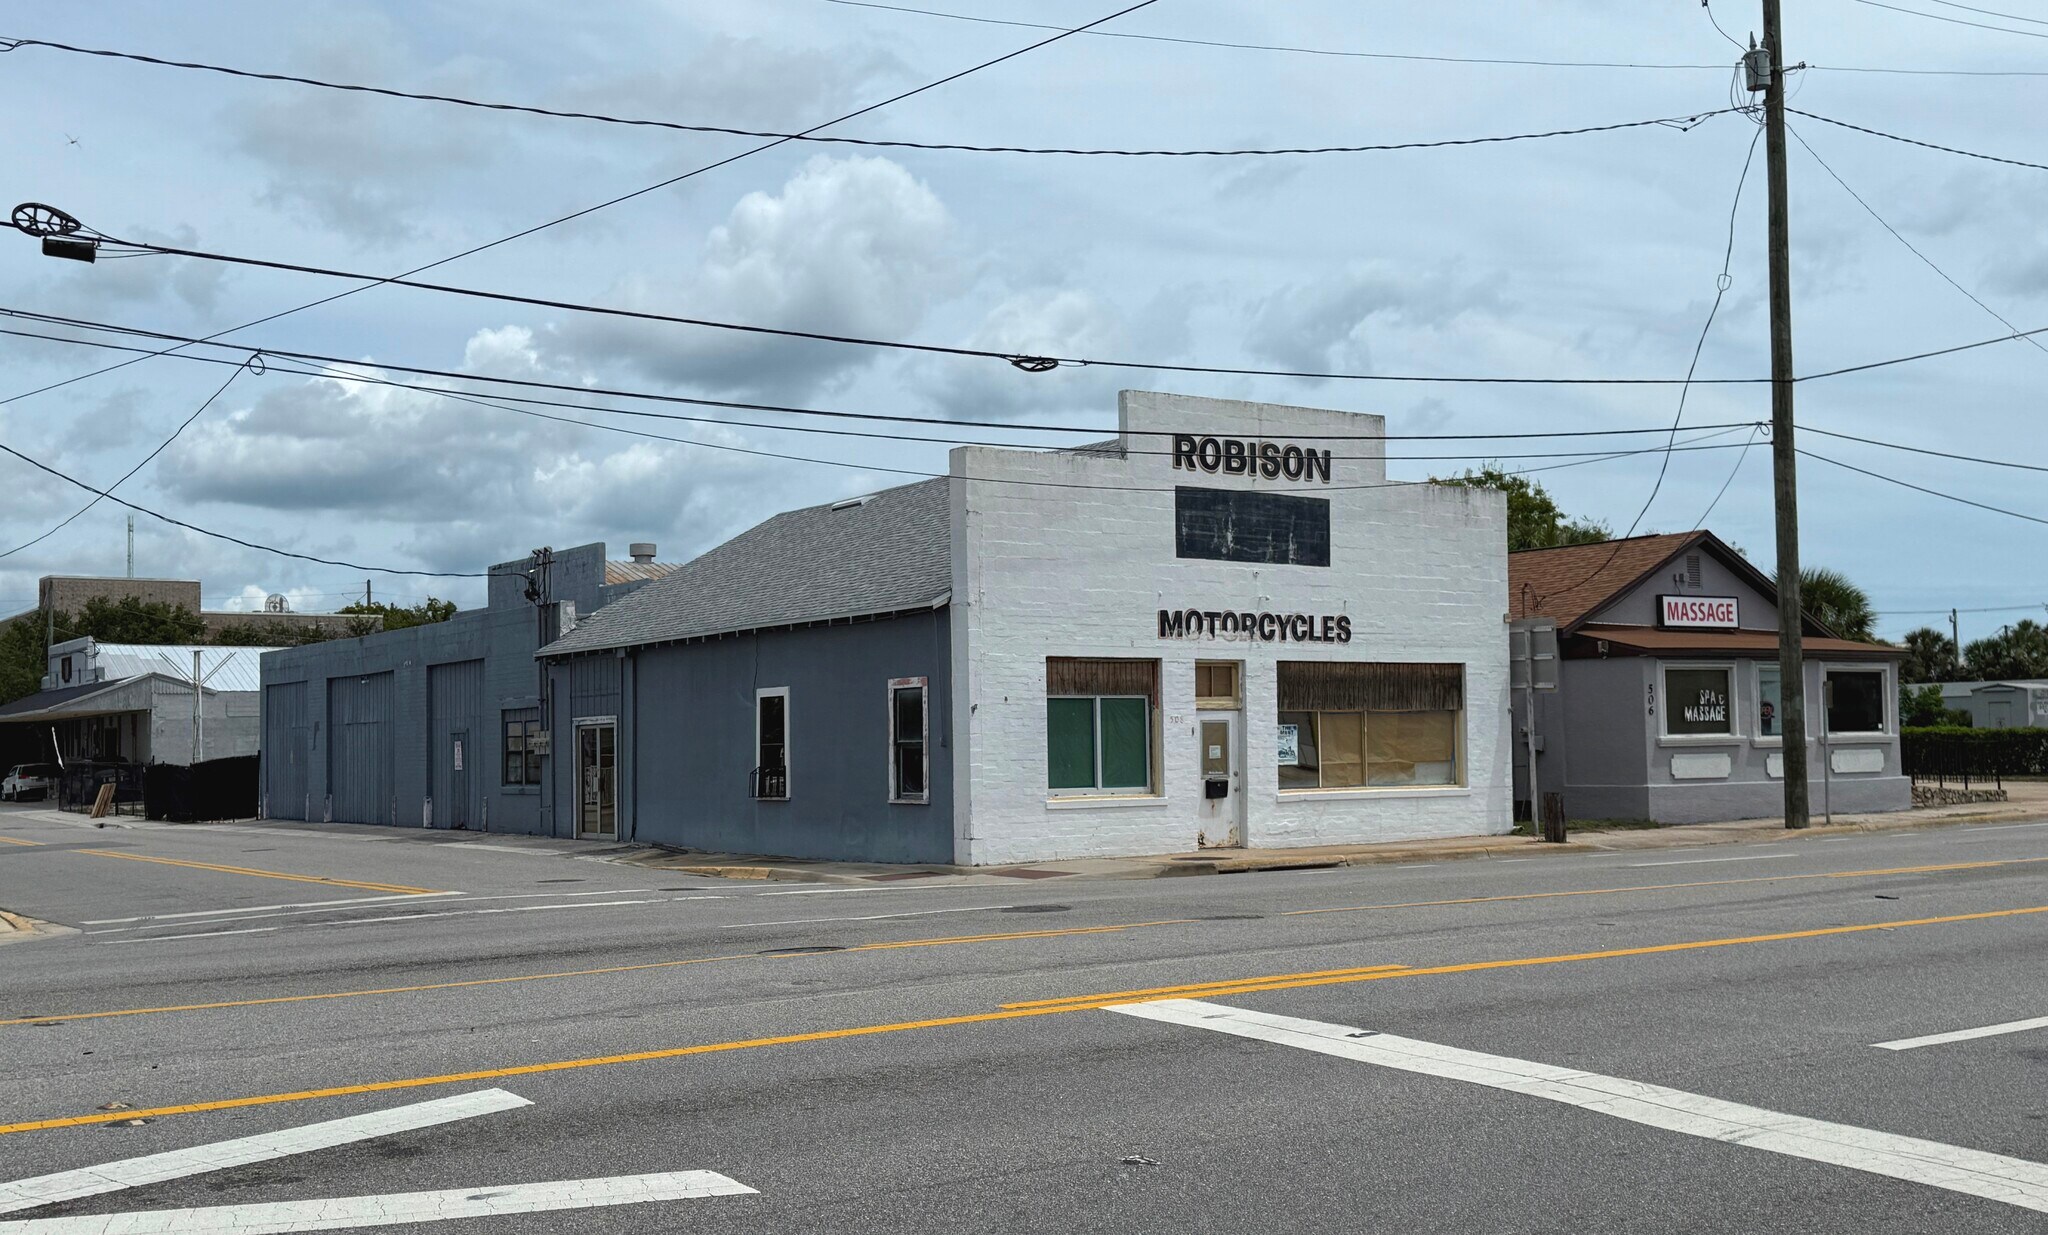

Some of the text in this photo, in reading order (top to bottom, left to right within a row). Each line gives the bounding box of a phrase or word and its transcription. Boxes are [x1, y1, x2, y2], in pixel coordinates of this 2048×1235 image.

[1173, 436, 1331, 483] ROBISON
[1667, 601, 1734, 622] MASSAGE
[1158, 608, 1351, 645] MOTORCYCLES
[1699, 689, 1716, 704] SPA
[1684, 706, 1726, 721] MASSAGE
